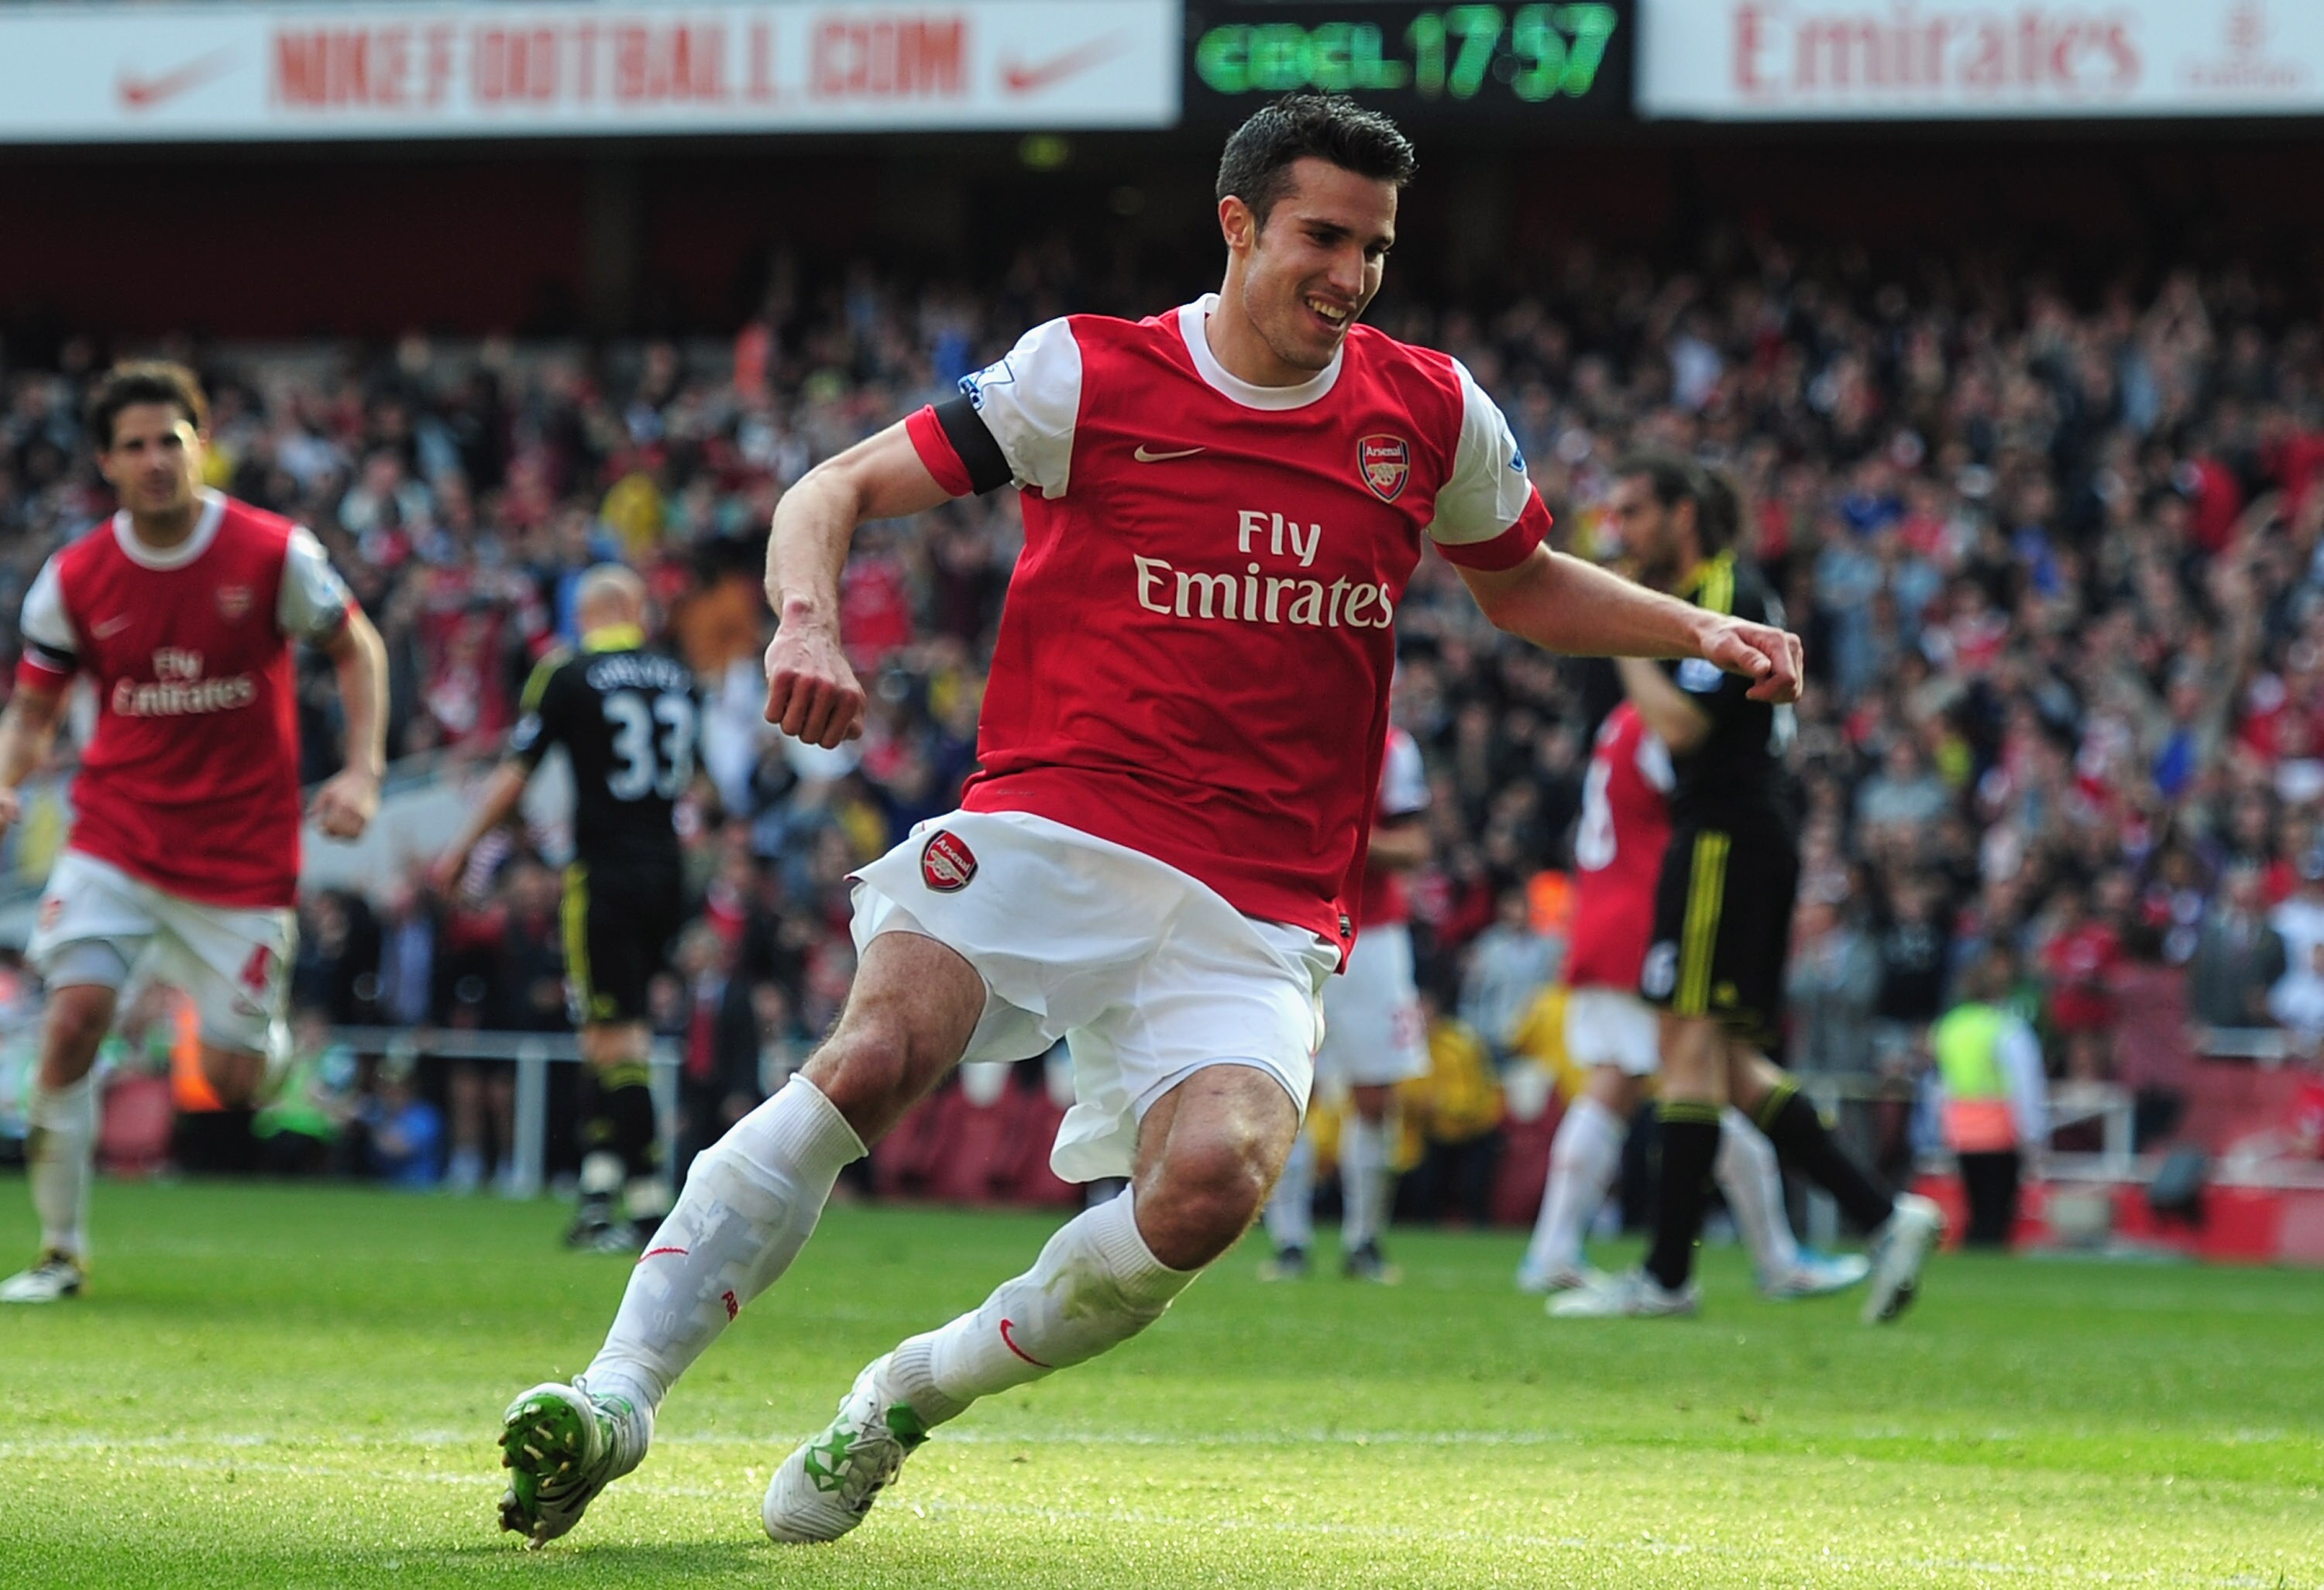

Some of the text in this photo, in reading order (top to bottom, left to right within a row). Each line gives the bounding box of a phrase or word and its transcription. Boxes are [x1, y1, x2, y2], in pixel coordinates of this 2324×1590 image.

[1732, 0, 2141, 97] Emirates
[1366, 445, 1401, 457] Arsenal
[1238, 510, 1321, 567] Fly
[1133, 553, 1394, 629] Emirates
[153, 647, 204, 681] Fly
[112, 675, 258, 717] Emirates
[603, 691, 696, 800] 33
[936, 839, 971, 872] Arsenal
